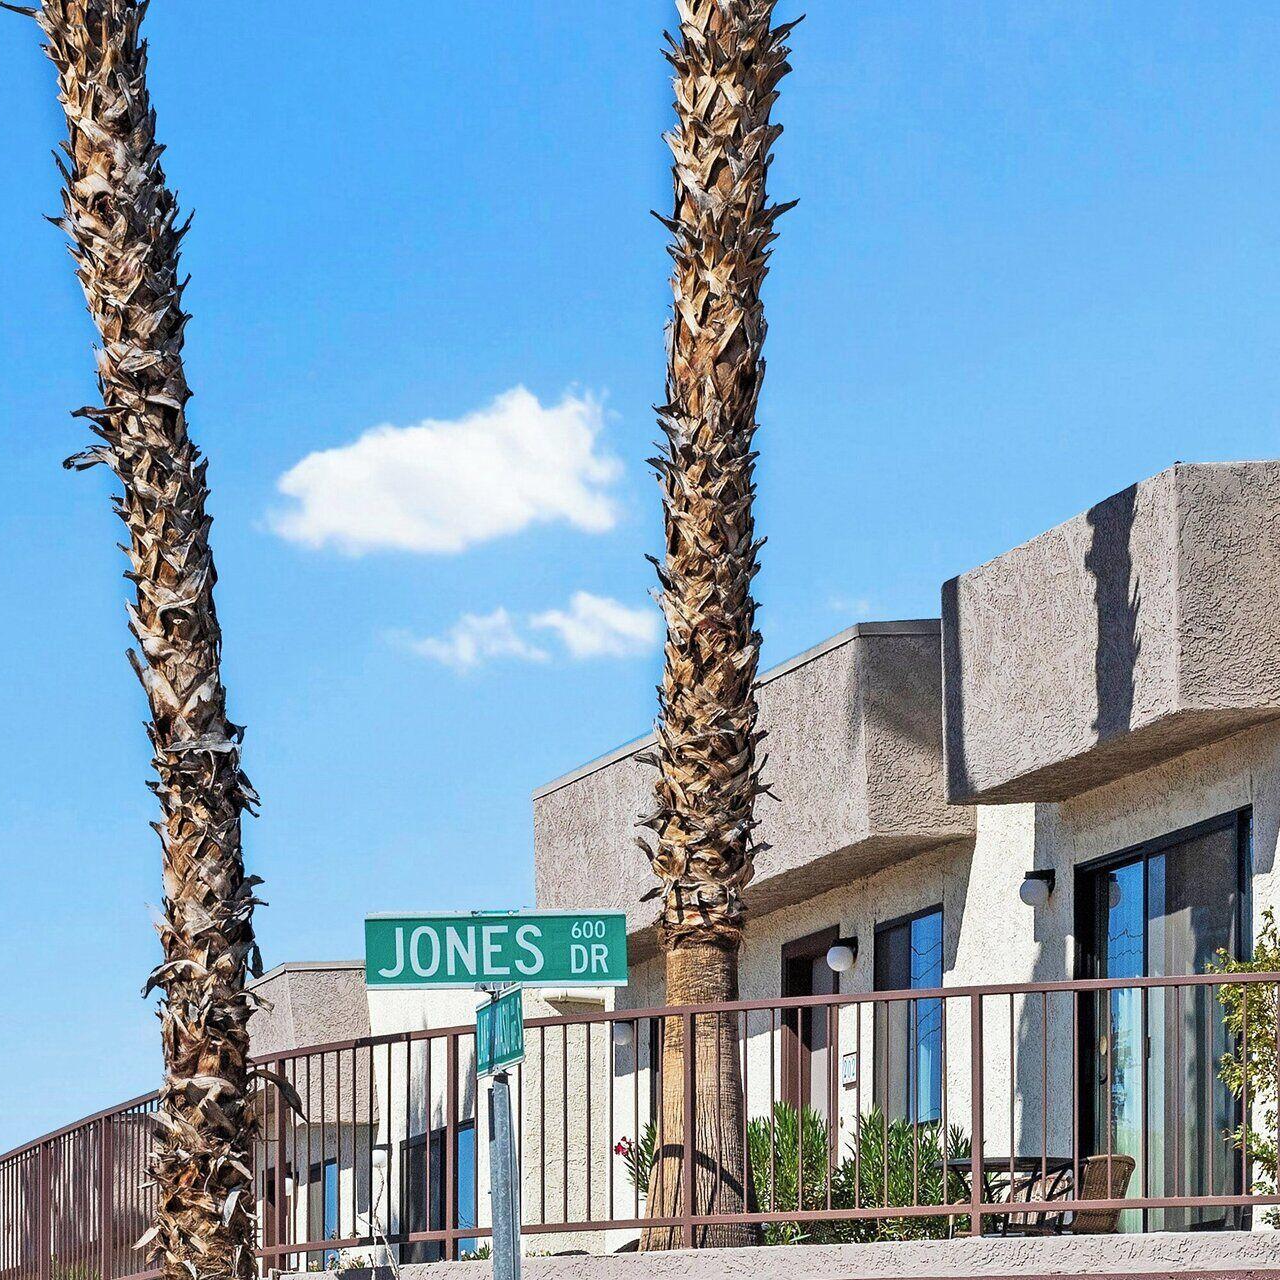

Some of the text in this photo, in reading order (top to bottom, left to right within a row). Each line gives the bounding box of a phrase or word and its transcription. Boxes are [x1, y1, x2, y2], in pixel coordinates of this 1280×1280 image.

[571, 920, 606, 938] 600
[378, 924, 609, 978] JONES DR
